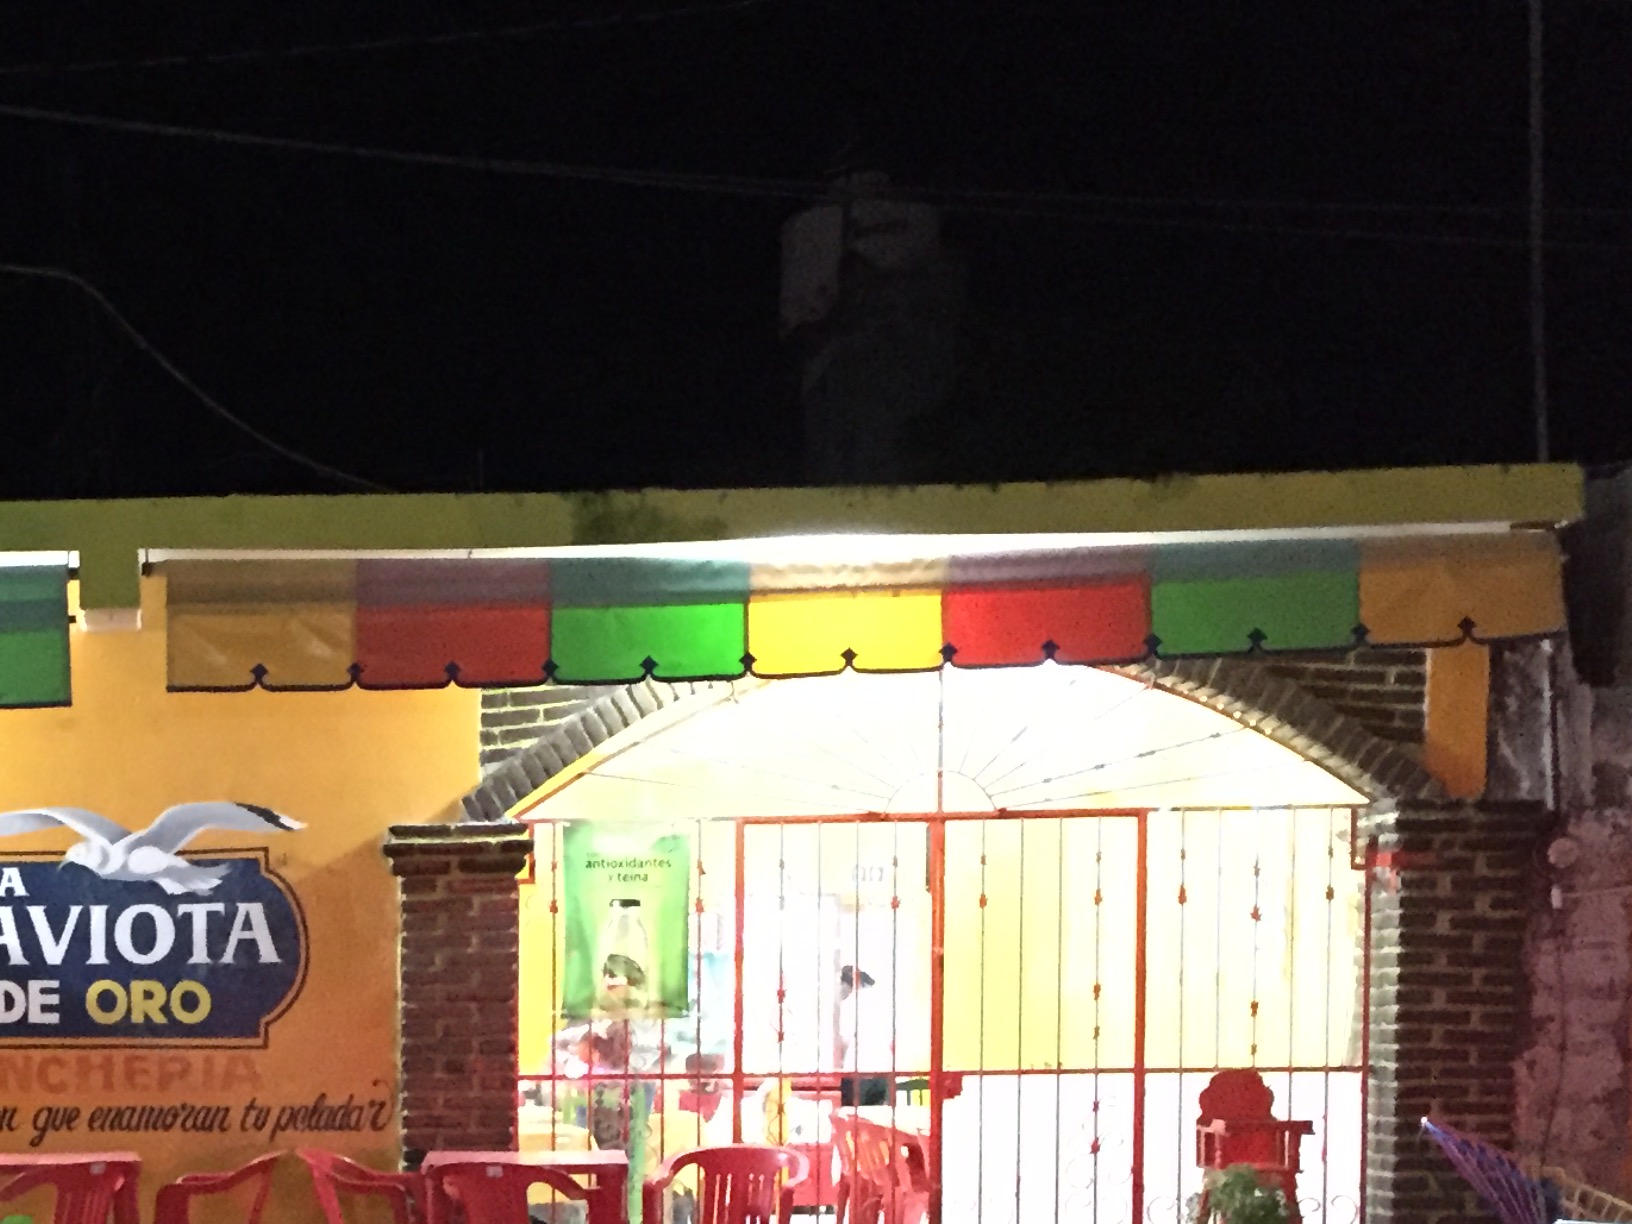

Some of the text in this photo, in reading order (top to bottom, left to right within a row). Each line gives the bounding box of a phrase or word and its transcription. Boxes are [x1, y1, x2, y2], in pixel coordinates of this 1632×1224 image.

[585, 857, 672, 869] antioxidantes
[85, 979, 212, 1025] ORO
[86, 1104, 231, 1132] enamoran
[238, 1097, 272, 1132] tu
